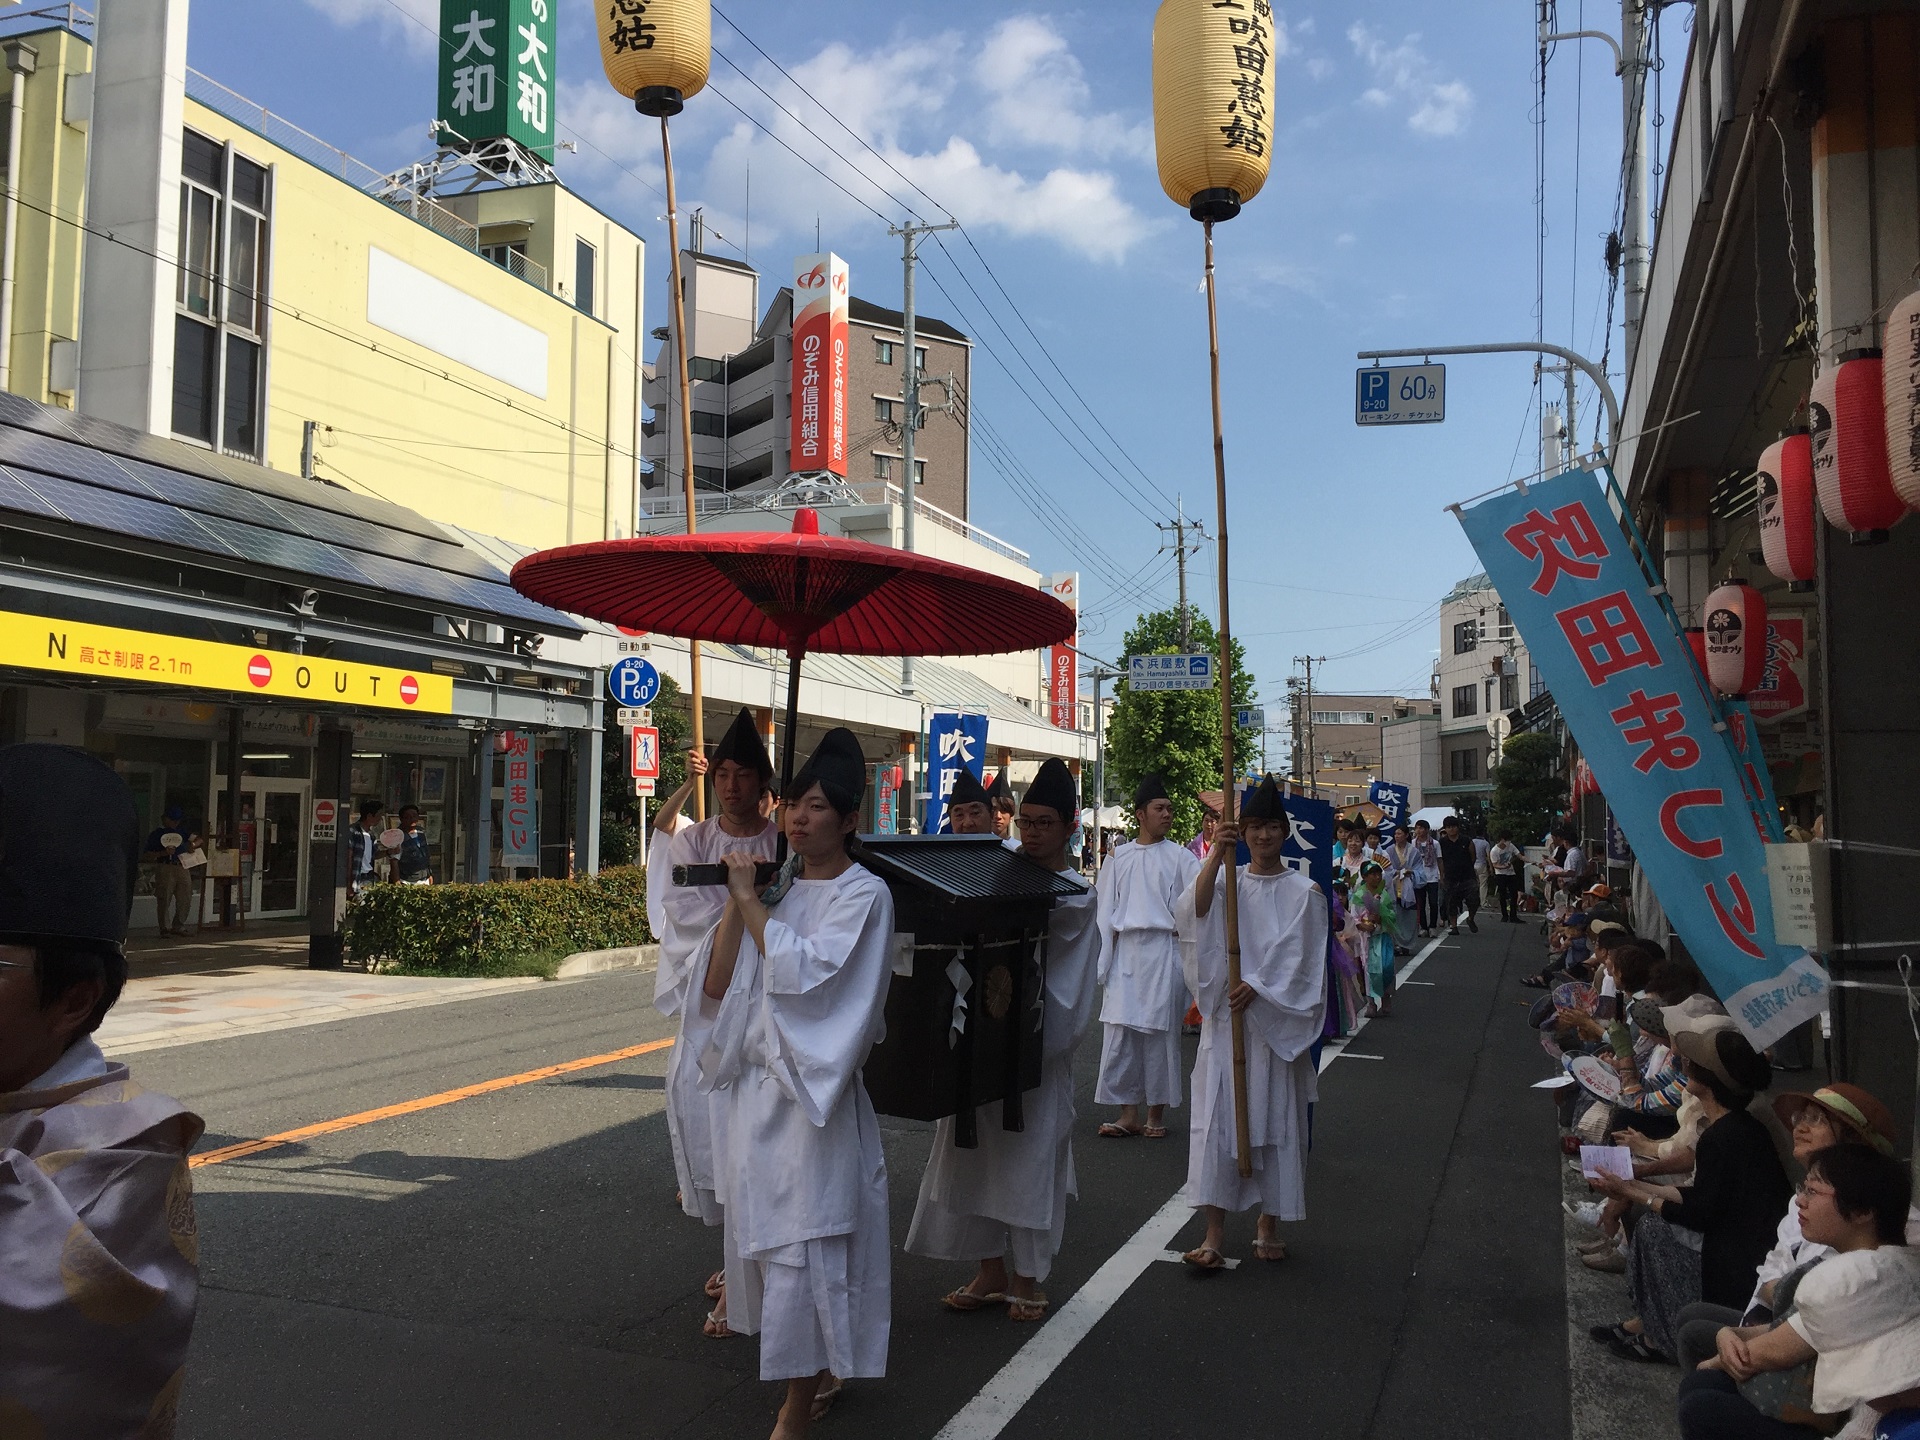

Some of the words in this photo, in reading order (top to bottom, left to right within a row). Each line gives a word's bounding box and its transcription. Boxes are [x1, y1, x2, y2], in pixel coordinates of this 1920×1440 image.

[452, 10, 496, 117] 大和
[801, 334, 820, 457] のぞみ信用組合
[1369, 375, 1384, 398] P
[833, 338, 845, 461] のぞみ信用組合
[1363, 400, 1386, 409] 9-20
[48, 632, 67, 660] N
[619, 642, 651, 652] 自動車
[79, 646, 193, 676] 高さ制限2.1m
[625, 660, 645, 669] 9-20
[1147, 657, 1187, 670] 浜屋敷
[620, 667, 640, 700] P
[1147, 670, 1187, 678] Hamayashiki
